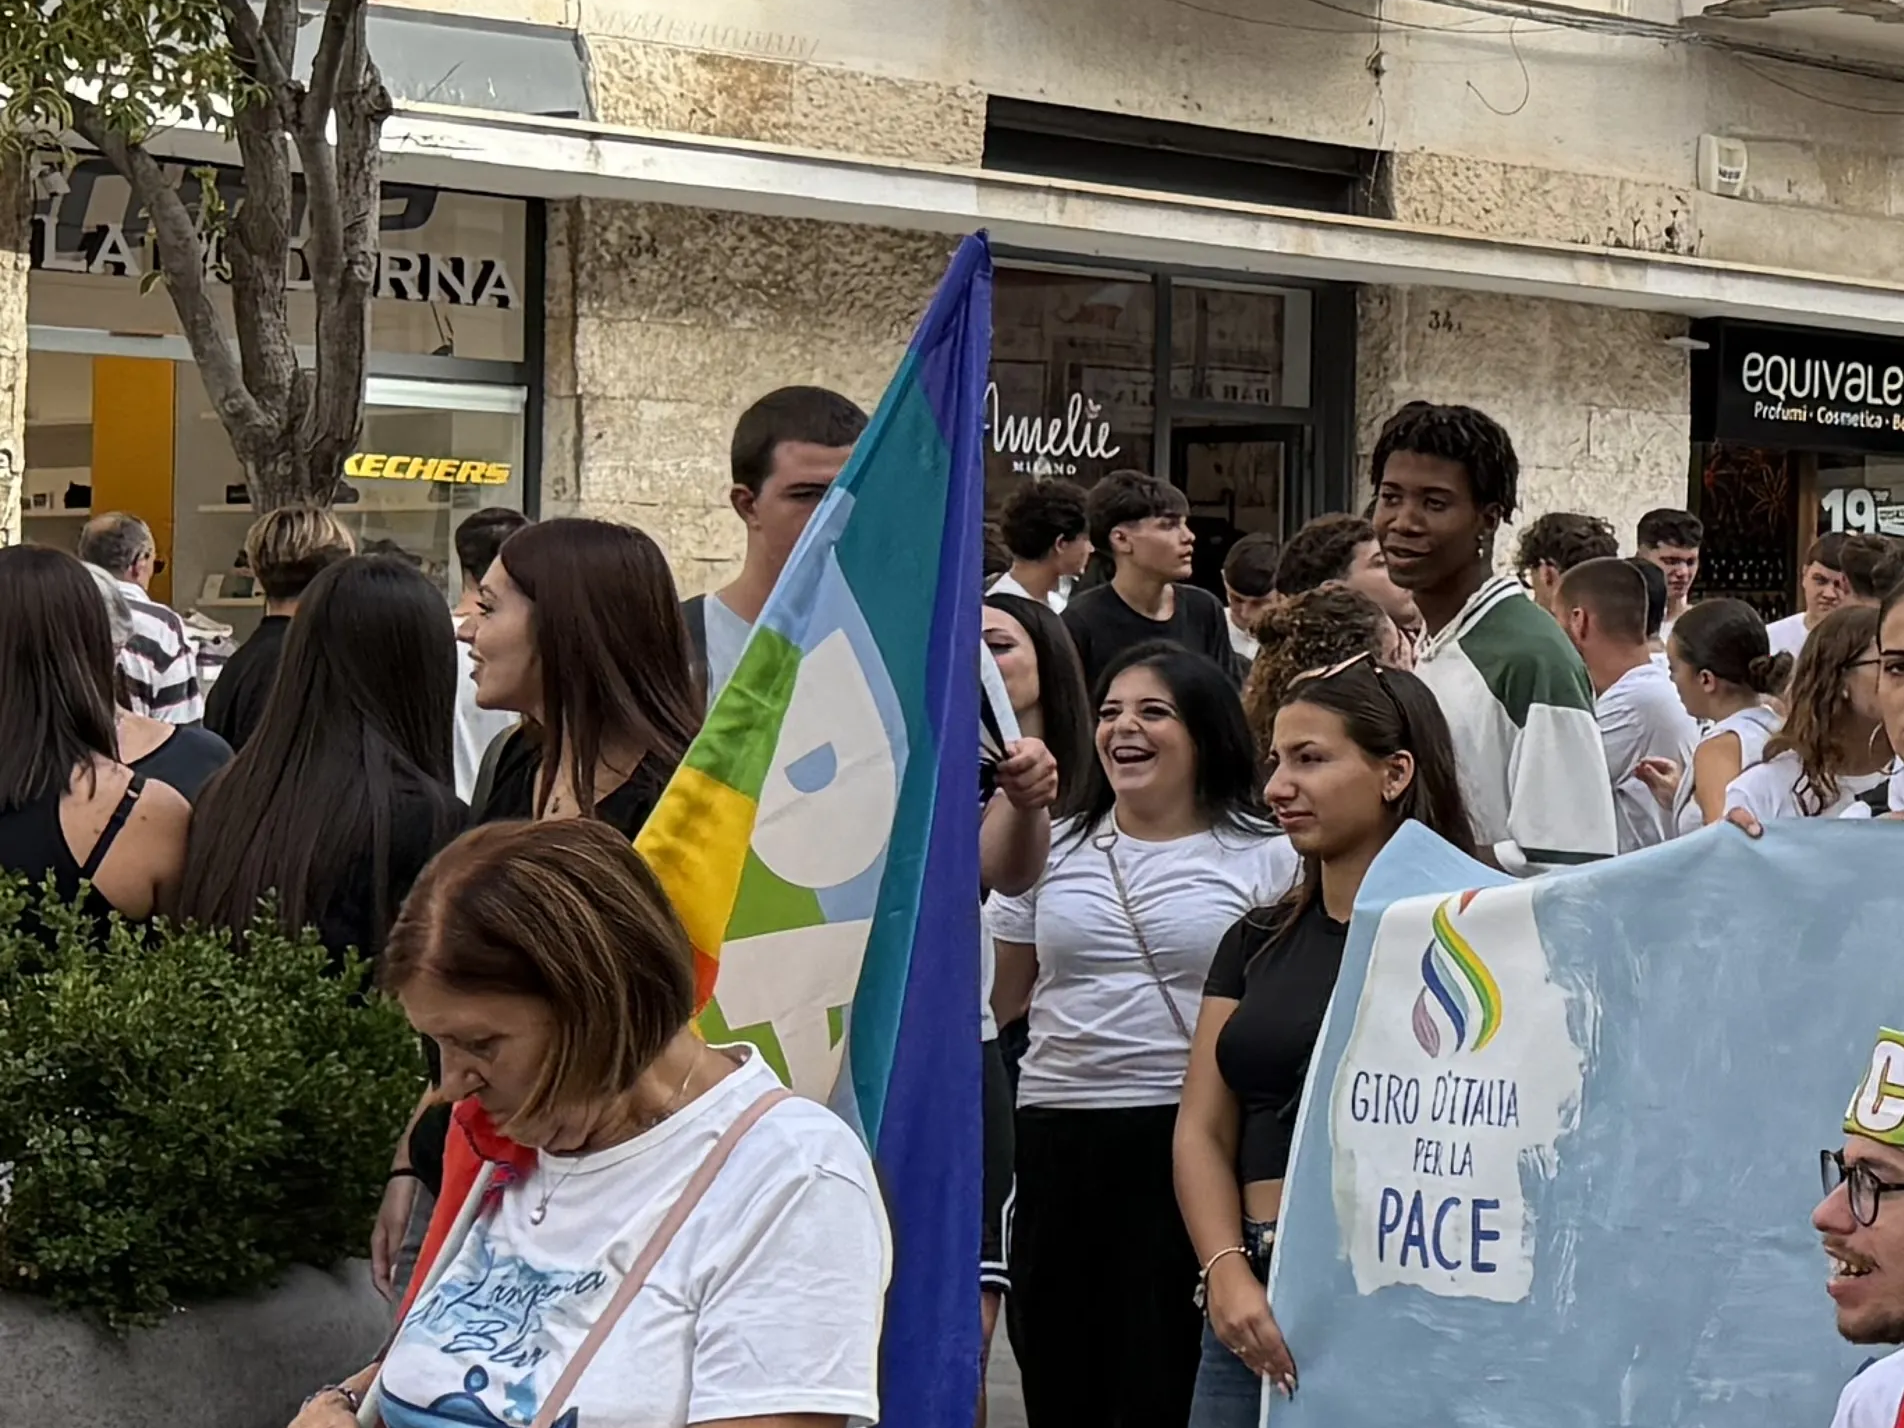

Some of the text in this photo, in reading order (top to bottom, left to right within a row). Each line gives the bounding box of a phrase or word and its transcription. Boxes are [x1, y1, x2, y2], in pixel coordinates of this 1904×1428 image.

[34, 214, 140, 276] LA
[983, 381, 1121, 459] Amelie
[1754, 401, 1808, 422] Profumi
[1816, 406, 1883, 429] Cosmetica
[343, 452, 512, 485] KECHERS
[1350, 1068, 1521, 1125] GIRO D'ITALIA
[1413, 1137, 1474, 1177] PER LA
[1378, 1187, 1501, 1275] PACE
